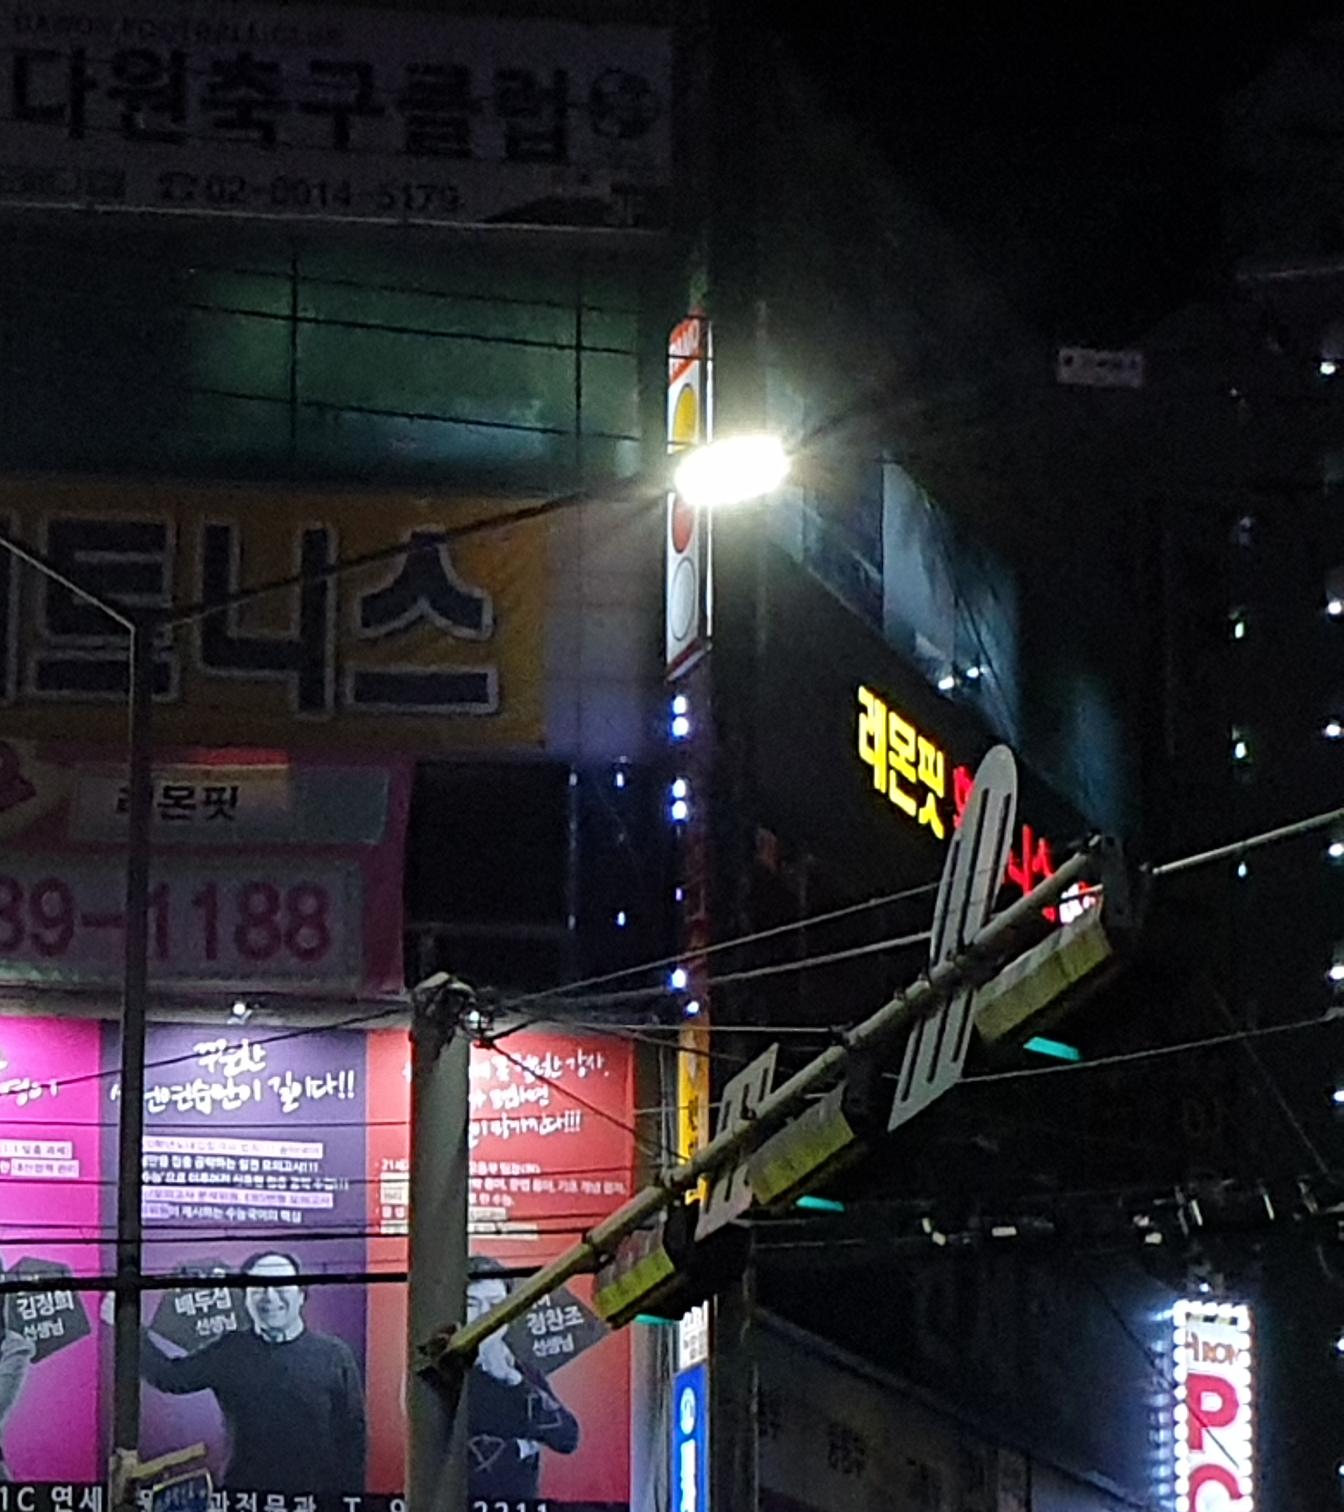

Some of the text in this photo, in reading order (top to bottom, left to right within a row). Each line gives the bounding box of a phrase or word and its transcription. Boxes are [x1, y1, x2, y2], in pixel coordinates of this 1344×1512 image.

[14, 48, 569, 165] 다원축구클럽
[857, 684, 946, 840] 레몬핏
[23, 1316, 65, 1342] 선생님
[195, 1311, 237, 1336] 선생님
